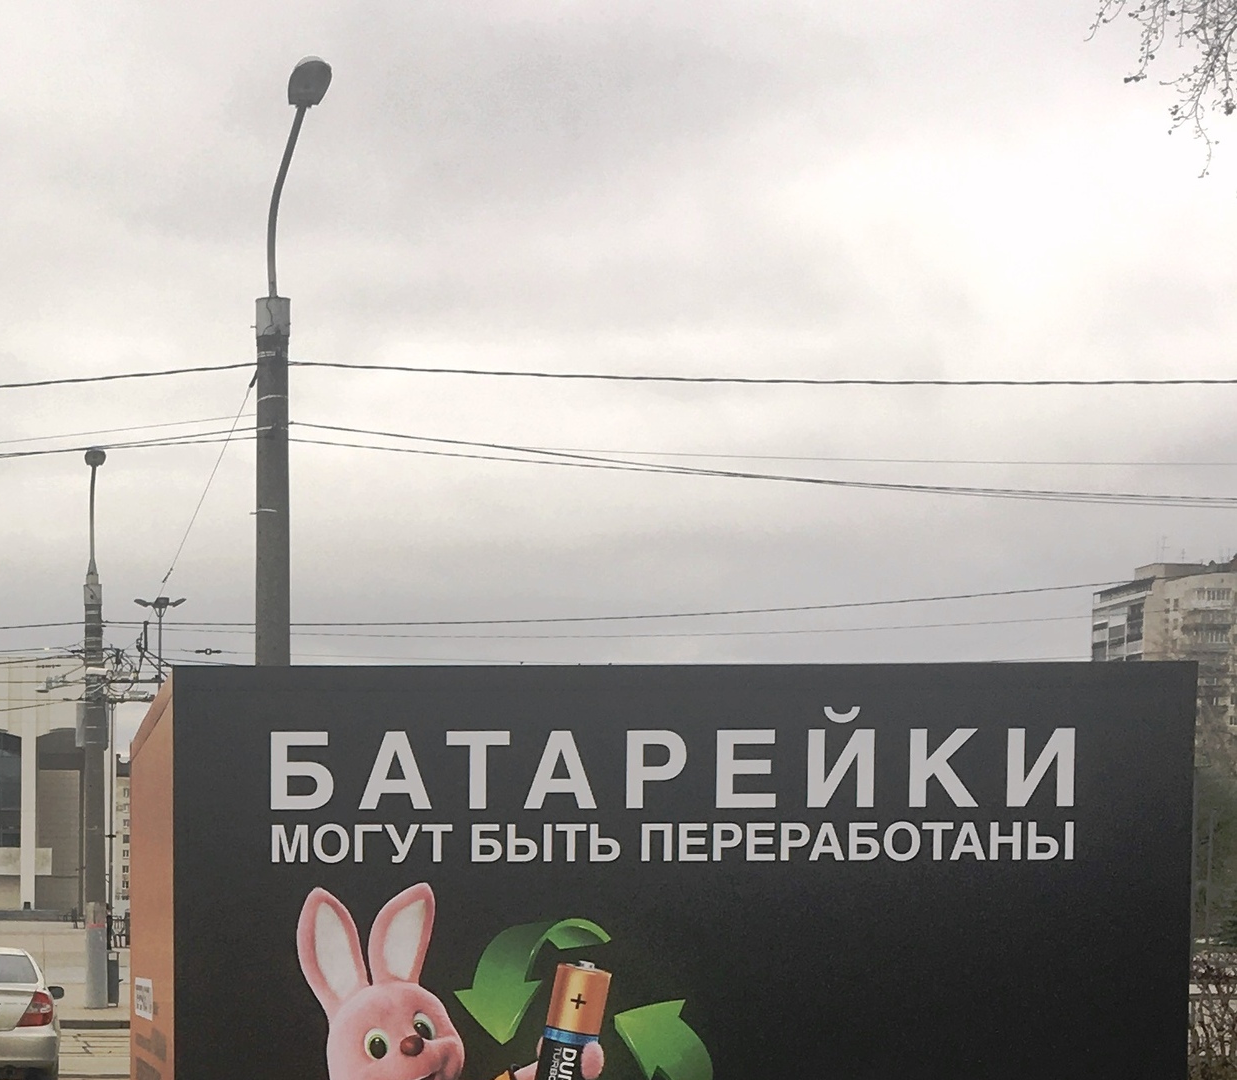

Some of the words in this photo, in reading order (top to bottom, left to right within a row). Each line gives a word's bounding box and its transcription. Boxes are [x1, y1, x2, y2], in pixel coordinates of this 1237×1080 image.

[270, 706, 1077, 811] БАТАРЕЙКИ
[271, 822, 454, 866] МОГУТ
[471, 822, 623, 865] БЫТЬ
[640, 820, 1076, 864] ПЕРЕРАБОТАНЫ
